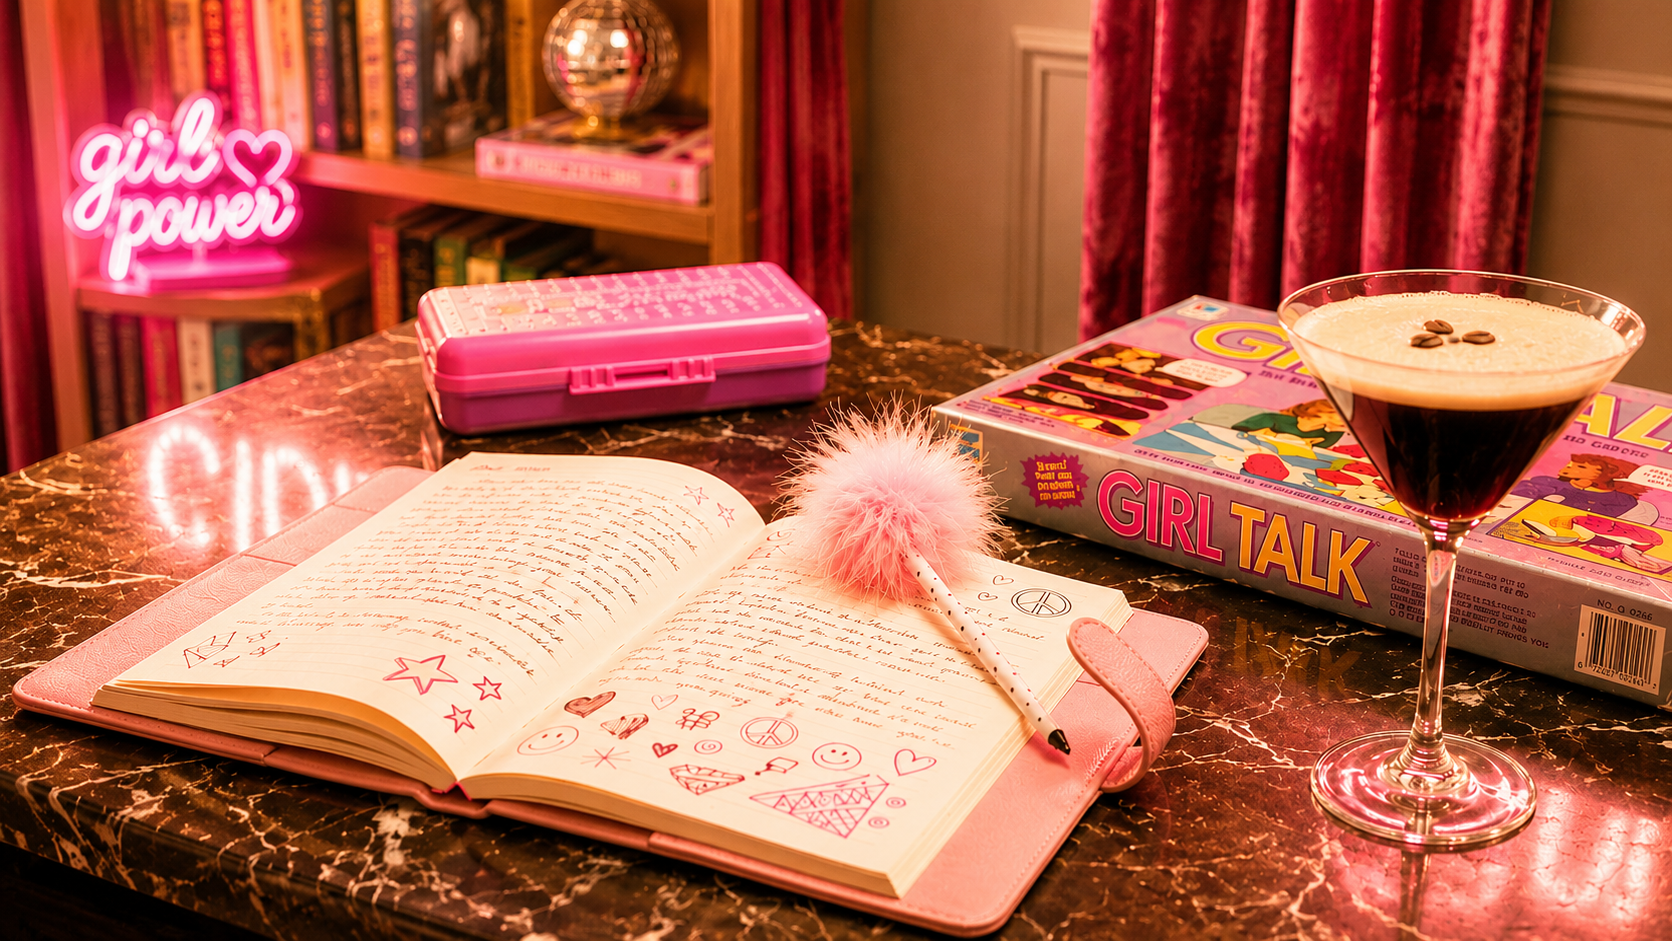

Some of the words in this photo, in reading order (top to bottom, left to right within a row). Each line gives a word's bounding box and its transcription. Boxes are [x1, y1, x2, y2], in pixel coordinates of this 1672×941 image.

[72, 95, 221, 232] girl
[107, 184, 297, 282] power
[1097, 468, 1225, 566] GIRL
[1229, 500, 1375, 607] TALK
[1597, 599, 1614, 611] NO.
